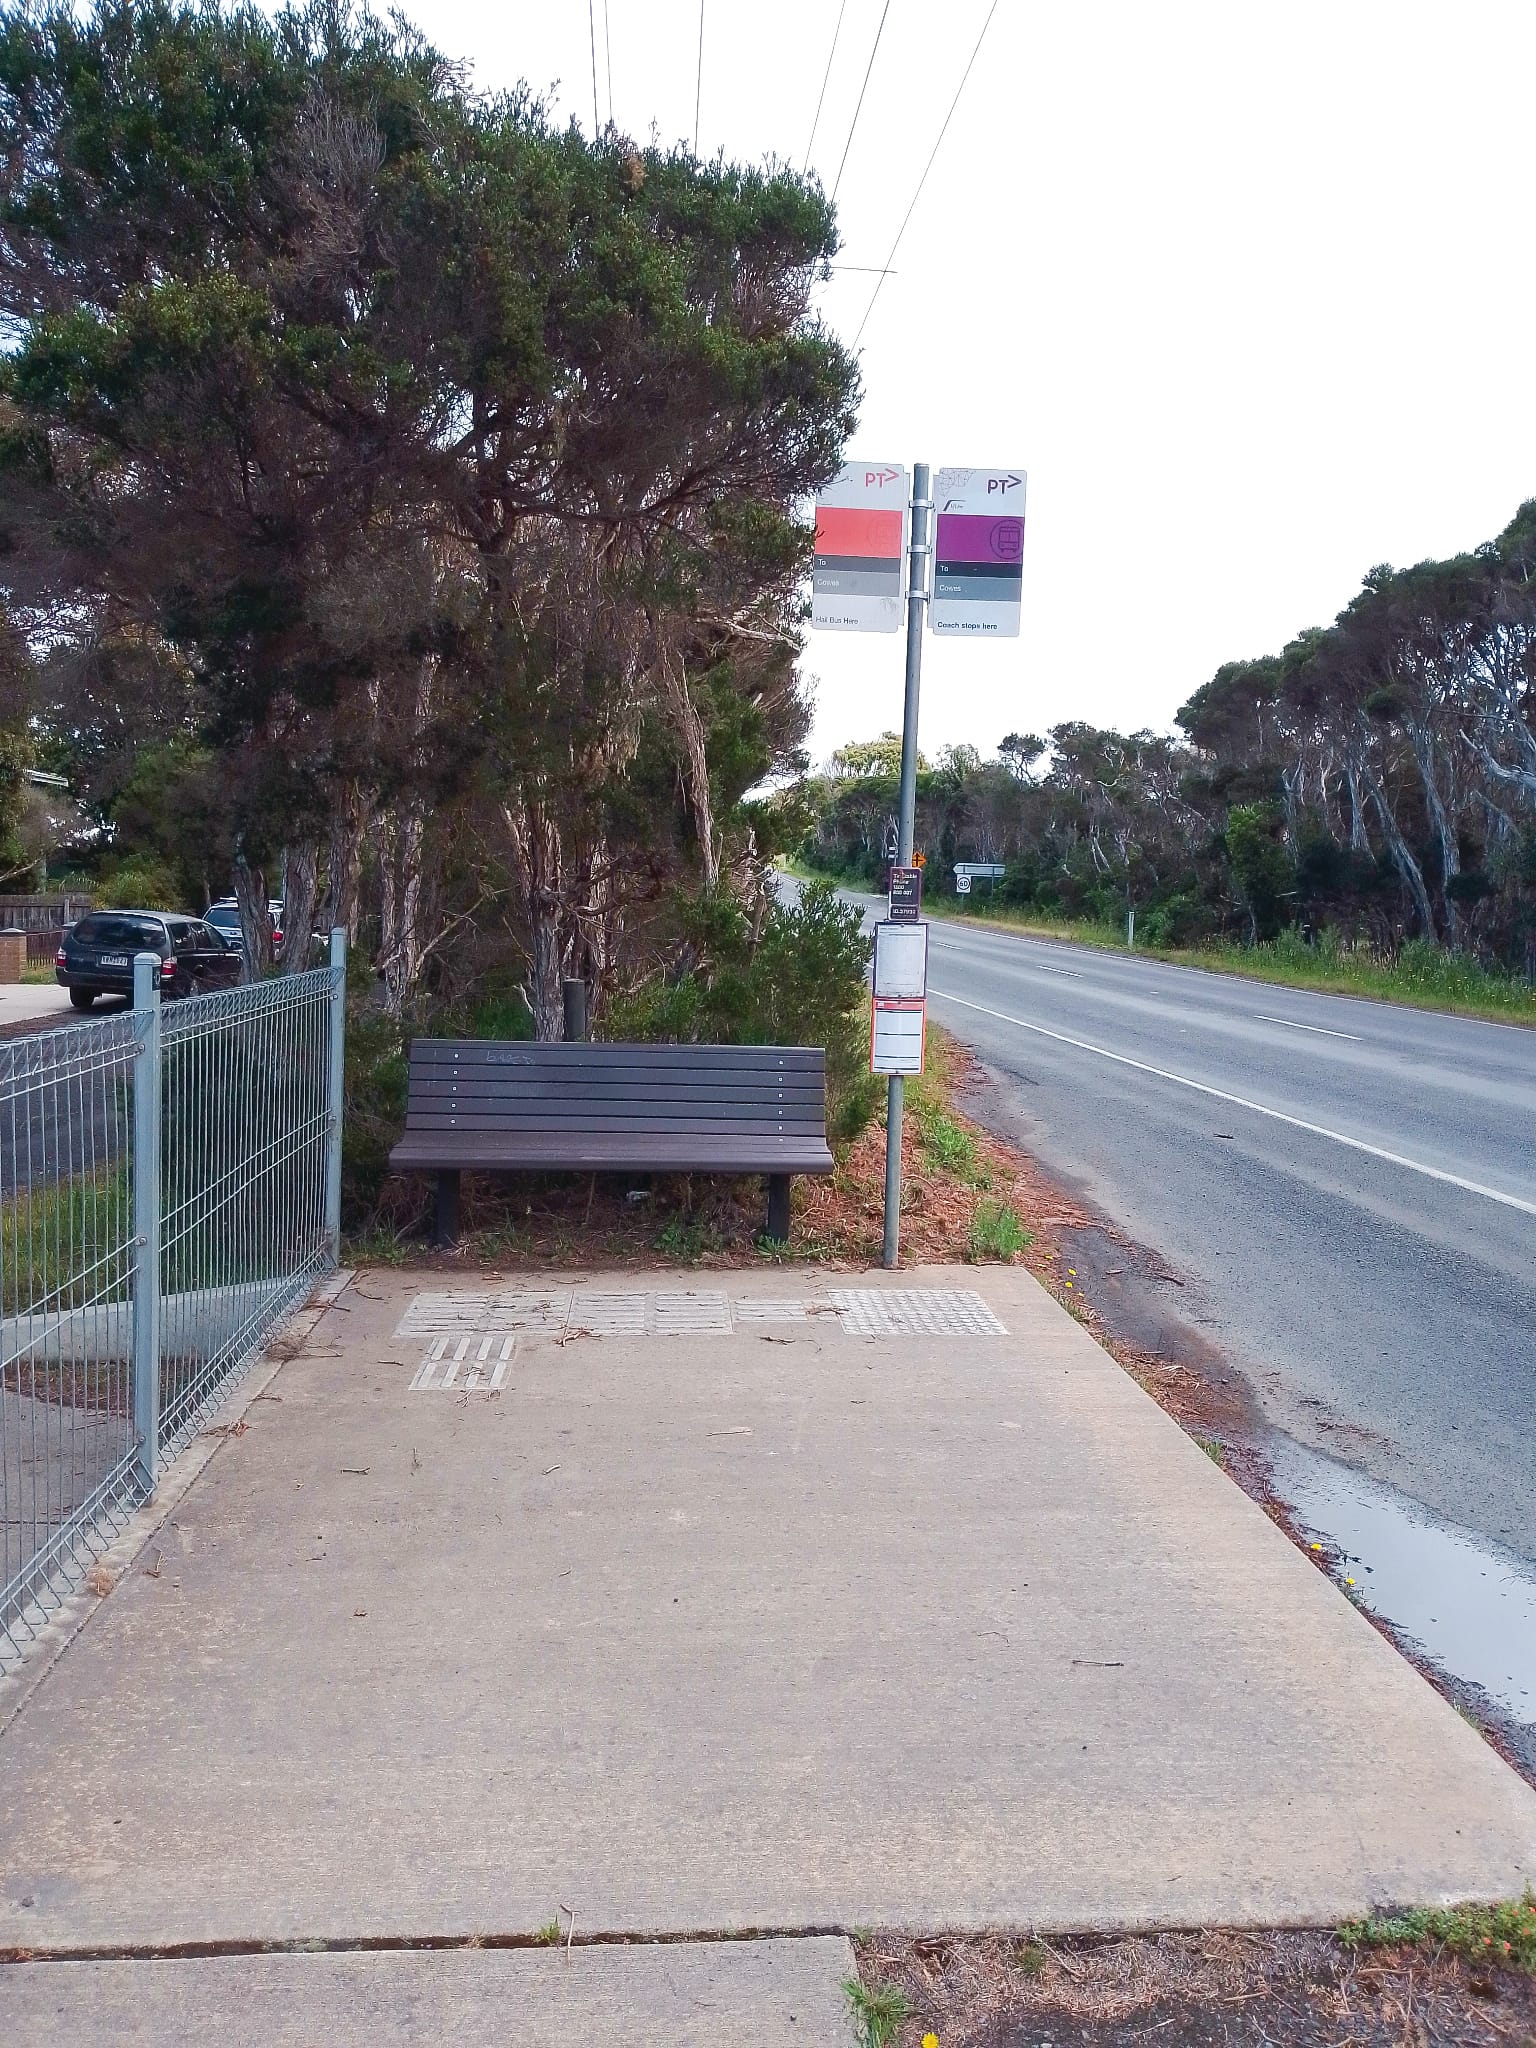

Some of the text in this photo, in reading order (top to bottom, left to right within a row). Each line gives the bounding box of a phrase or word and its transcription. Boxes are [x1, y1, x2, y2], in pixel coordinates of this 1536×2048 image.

[817, 558, 827, 566] To
[939, 584, 962, 592] Cowes
[829, 616, 842, 624] Bus
[937, 621, 960, 629] Coach
[982, 622, 998, 630] here
